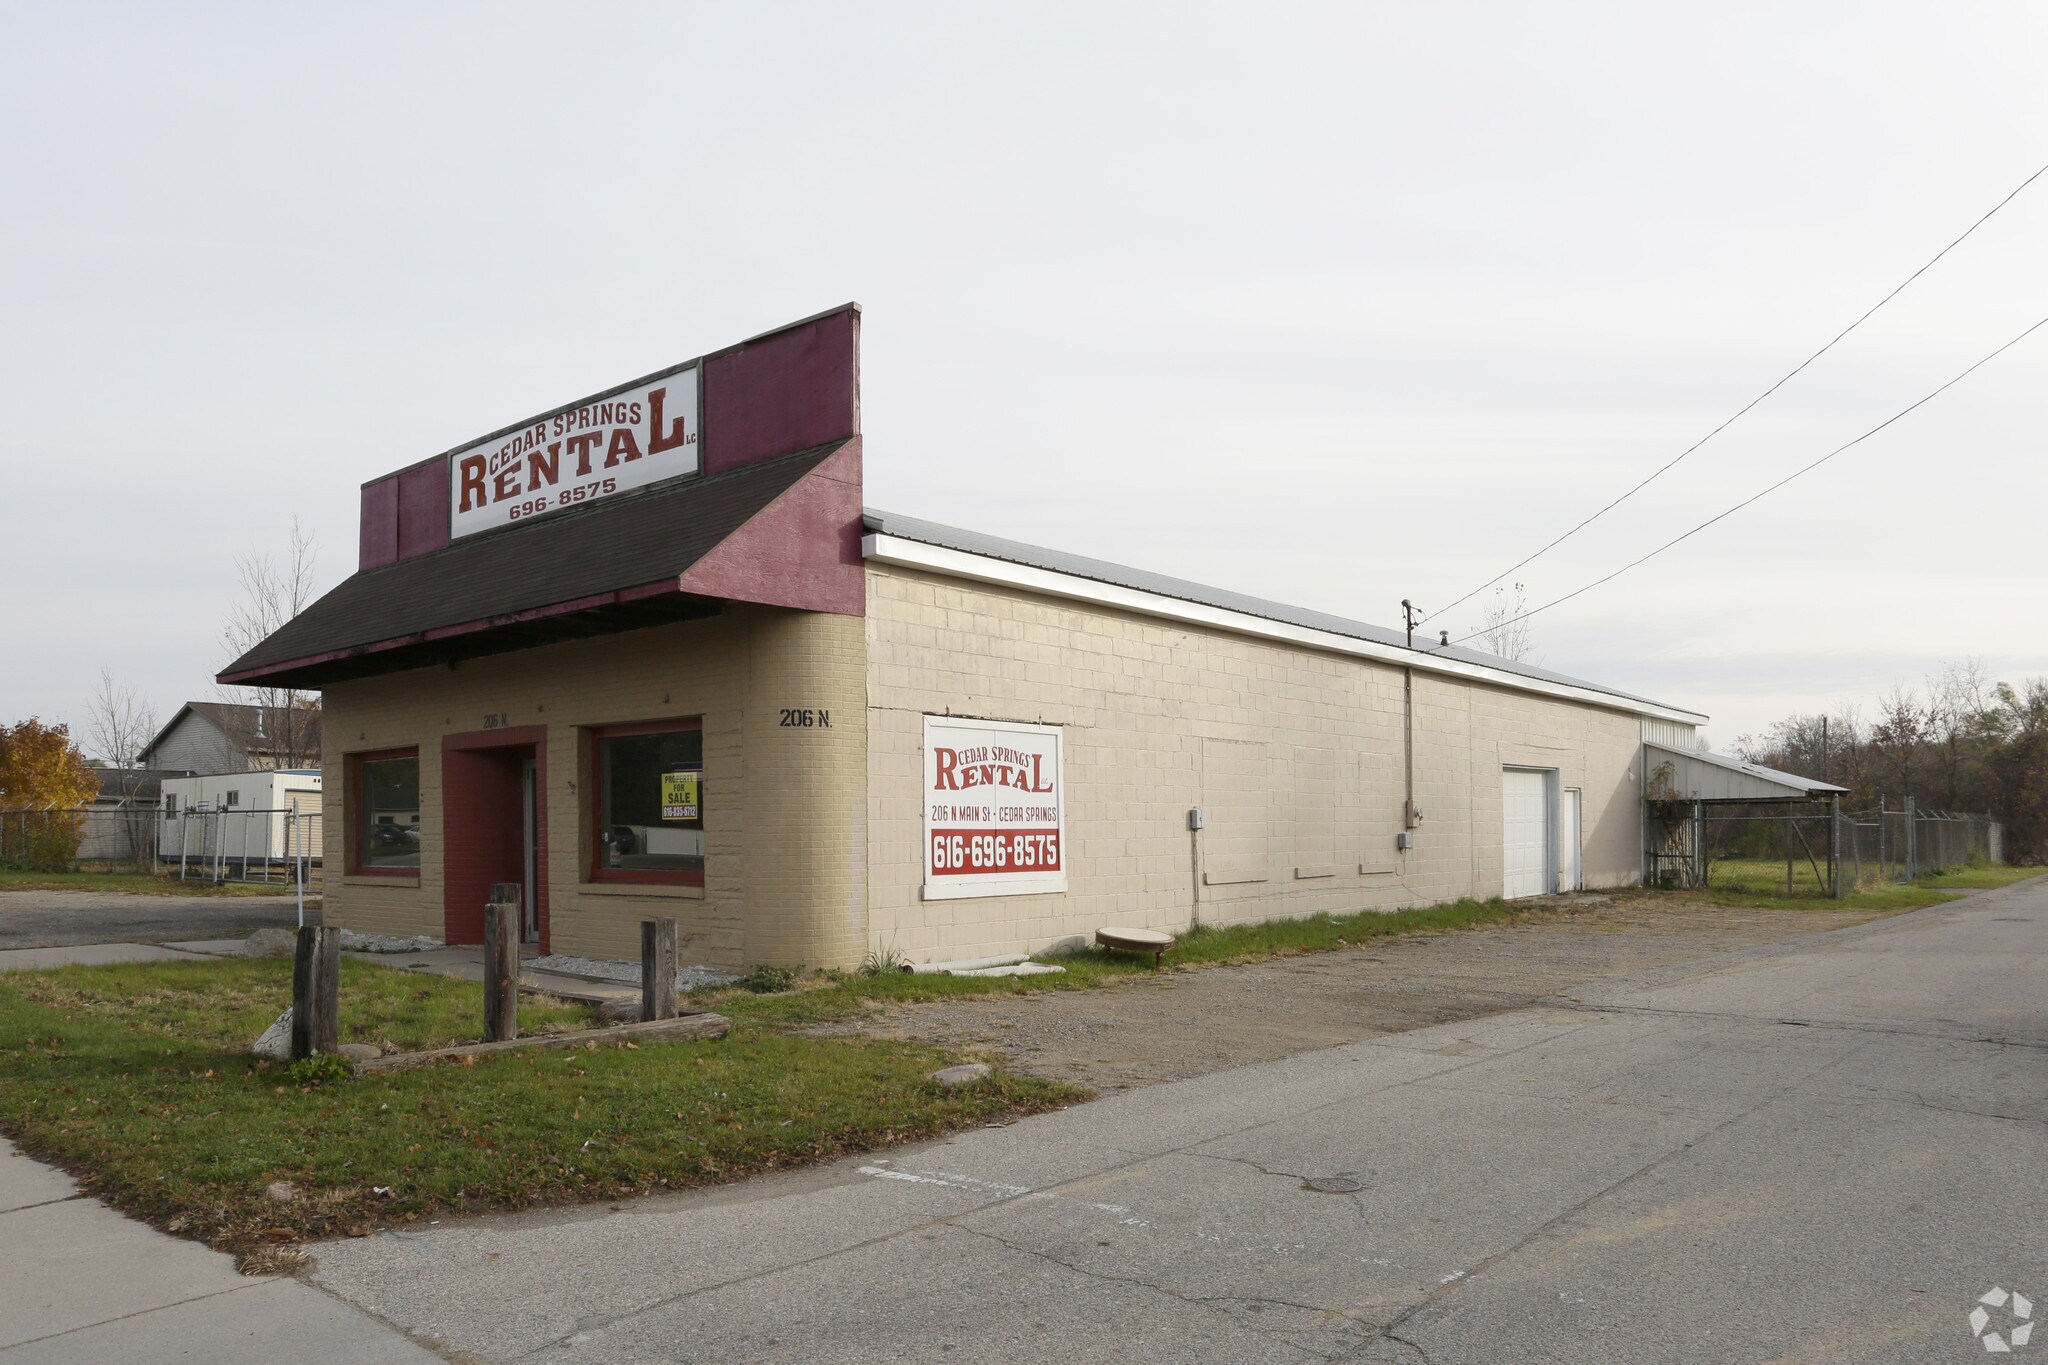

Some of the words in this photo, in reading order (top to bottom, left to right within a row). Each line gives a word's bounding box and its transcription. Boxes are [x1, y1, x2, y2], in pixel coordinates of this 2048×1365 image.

[489, 423, 547, 475] CEDAR
[553, 402, 642, 437] SPRINGS
[686, 433, 696, 445] LC
[459, 387, 685, 514] RENTAL
[509, 478, 617, 520] 696-8575
[484, 714, 498, 728] 206
[780, 709, 814, 727] 206
[819, 709, 832, 728] N.
[958, 747, 988, 766] CEDAR
[992, 746, 1031, 768] SPRINGS
[664, 775, 693, 783] PROPERTY
[934, 747, 1053, 793] RENTAL
[668, 793, 691, 804] SALE
[932, 805, 948, 822] 206
[960, 806, 980, 821] MAIN
[999, 807, 1023, 822] CEDAR
[1025, 807, 1057, 822] SPRINGS
[933, 834, 1057, 868] 616-696-8575
